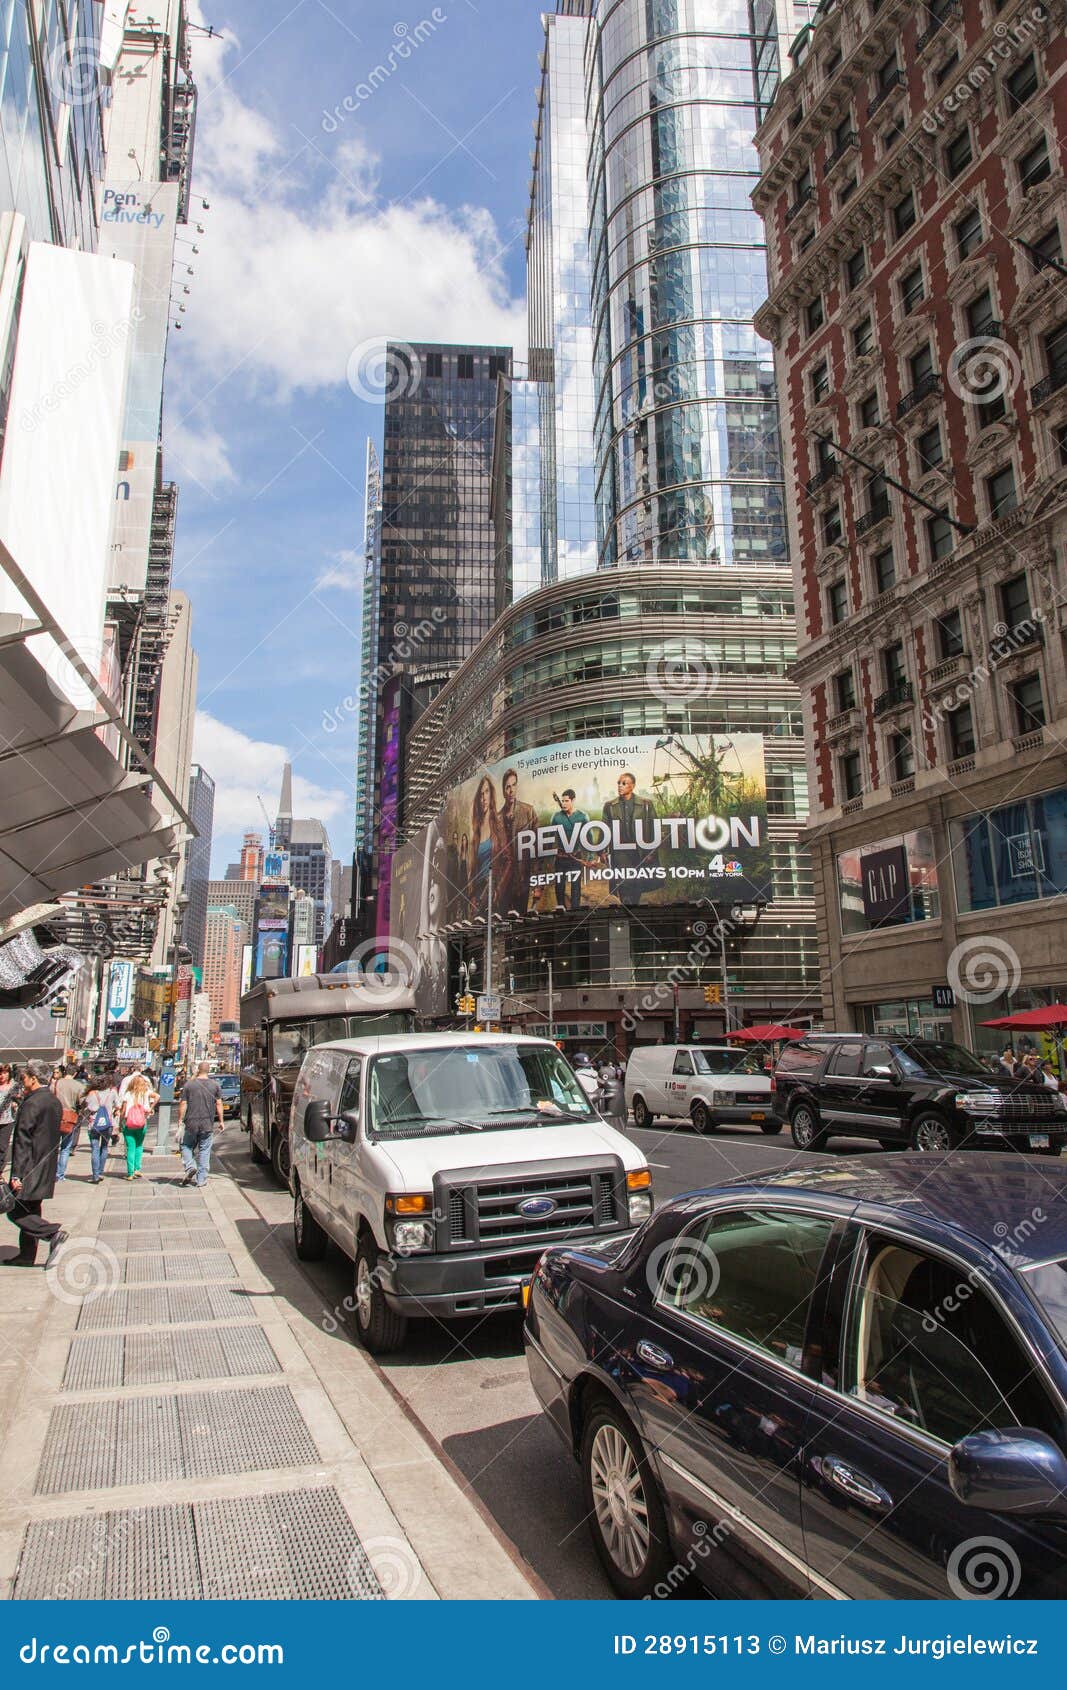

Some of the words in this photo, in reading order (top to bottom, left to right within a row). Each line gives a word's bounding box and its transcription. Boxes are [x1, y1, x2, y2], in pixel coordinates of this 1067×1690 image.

[414, 671, 457, 684] MARKE
[517, 759, 525, 769] 15
[525, 755, 548, 769] years
[549, 751, 573, 761] after
[575, 747, 591, 758] the
[593, 745, 649, 756] blackout...
[532, 765, 559, 779] power
[560, 762, 570, 772] is
[571, 757, 629, 770] everything.
[517, 814, 760, 861] REVOLUTION
[708, 854, 726, 873] 4
[529, 872, 563, 887] SEPT
[565, 870, 582, 882] 17
[589, 867, 667, 881] MONDAYS
[868, 864, 897, 904] GAP
